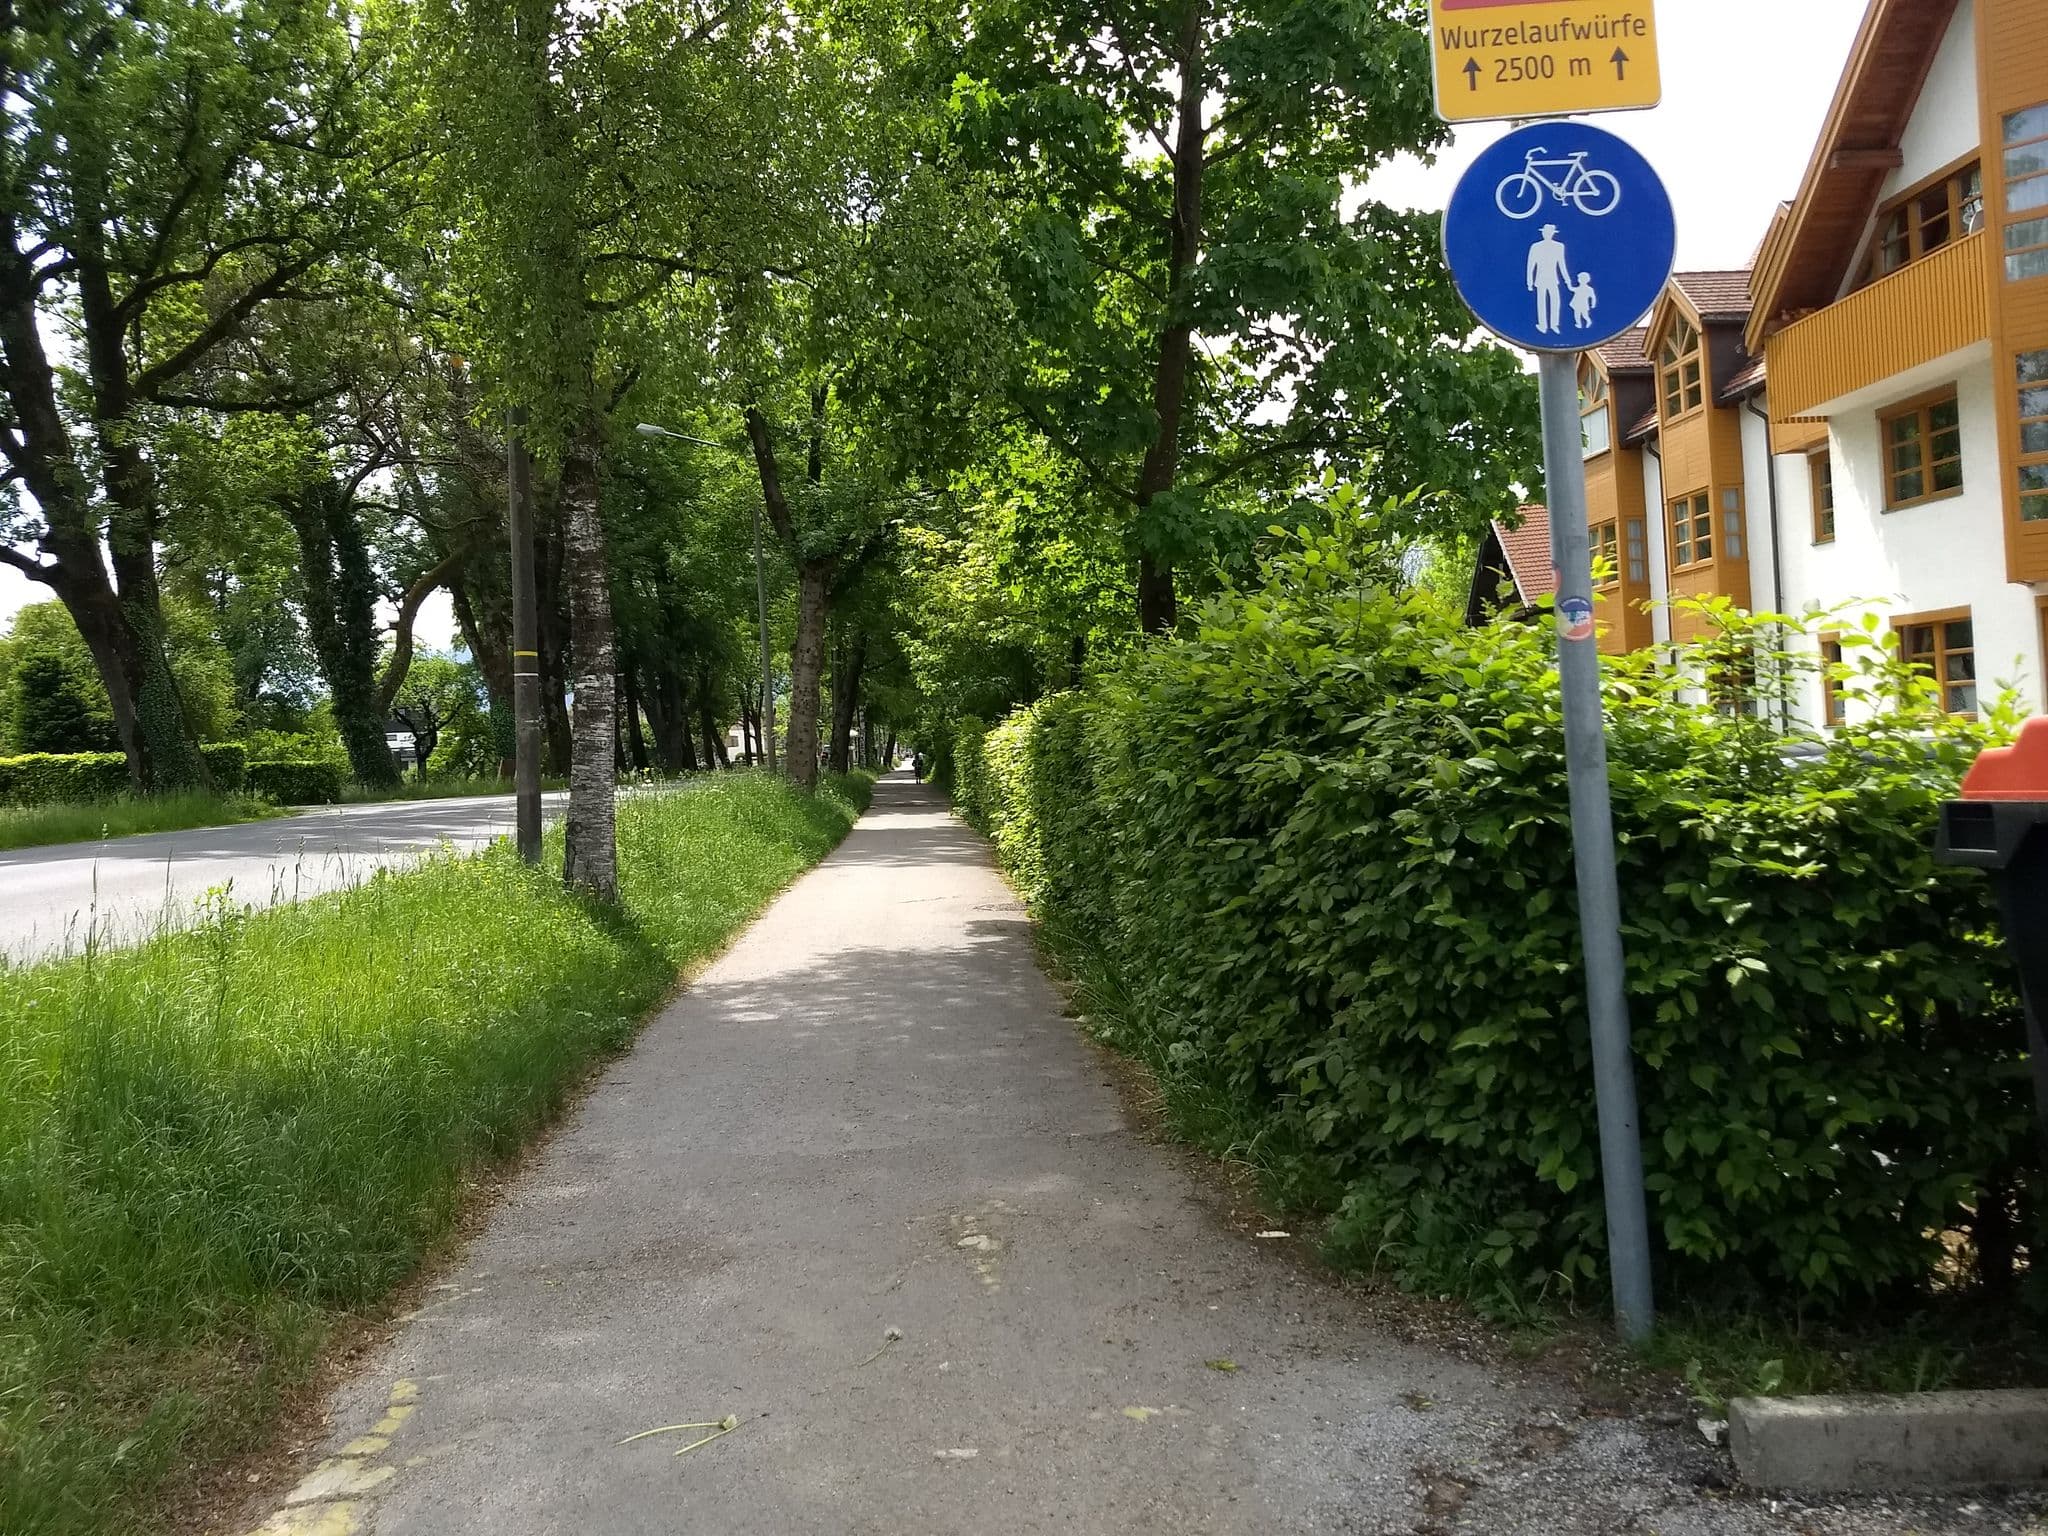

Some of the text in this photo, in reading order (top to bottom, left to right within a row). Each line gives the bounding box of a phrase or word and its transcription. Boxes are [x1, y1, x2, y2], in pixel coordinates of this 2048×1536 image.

[1441, 14, 1646, 50] Wurzelaufwürfe
[1494, 55, 1591, 82] 2500 m
